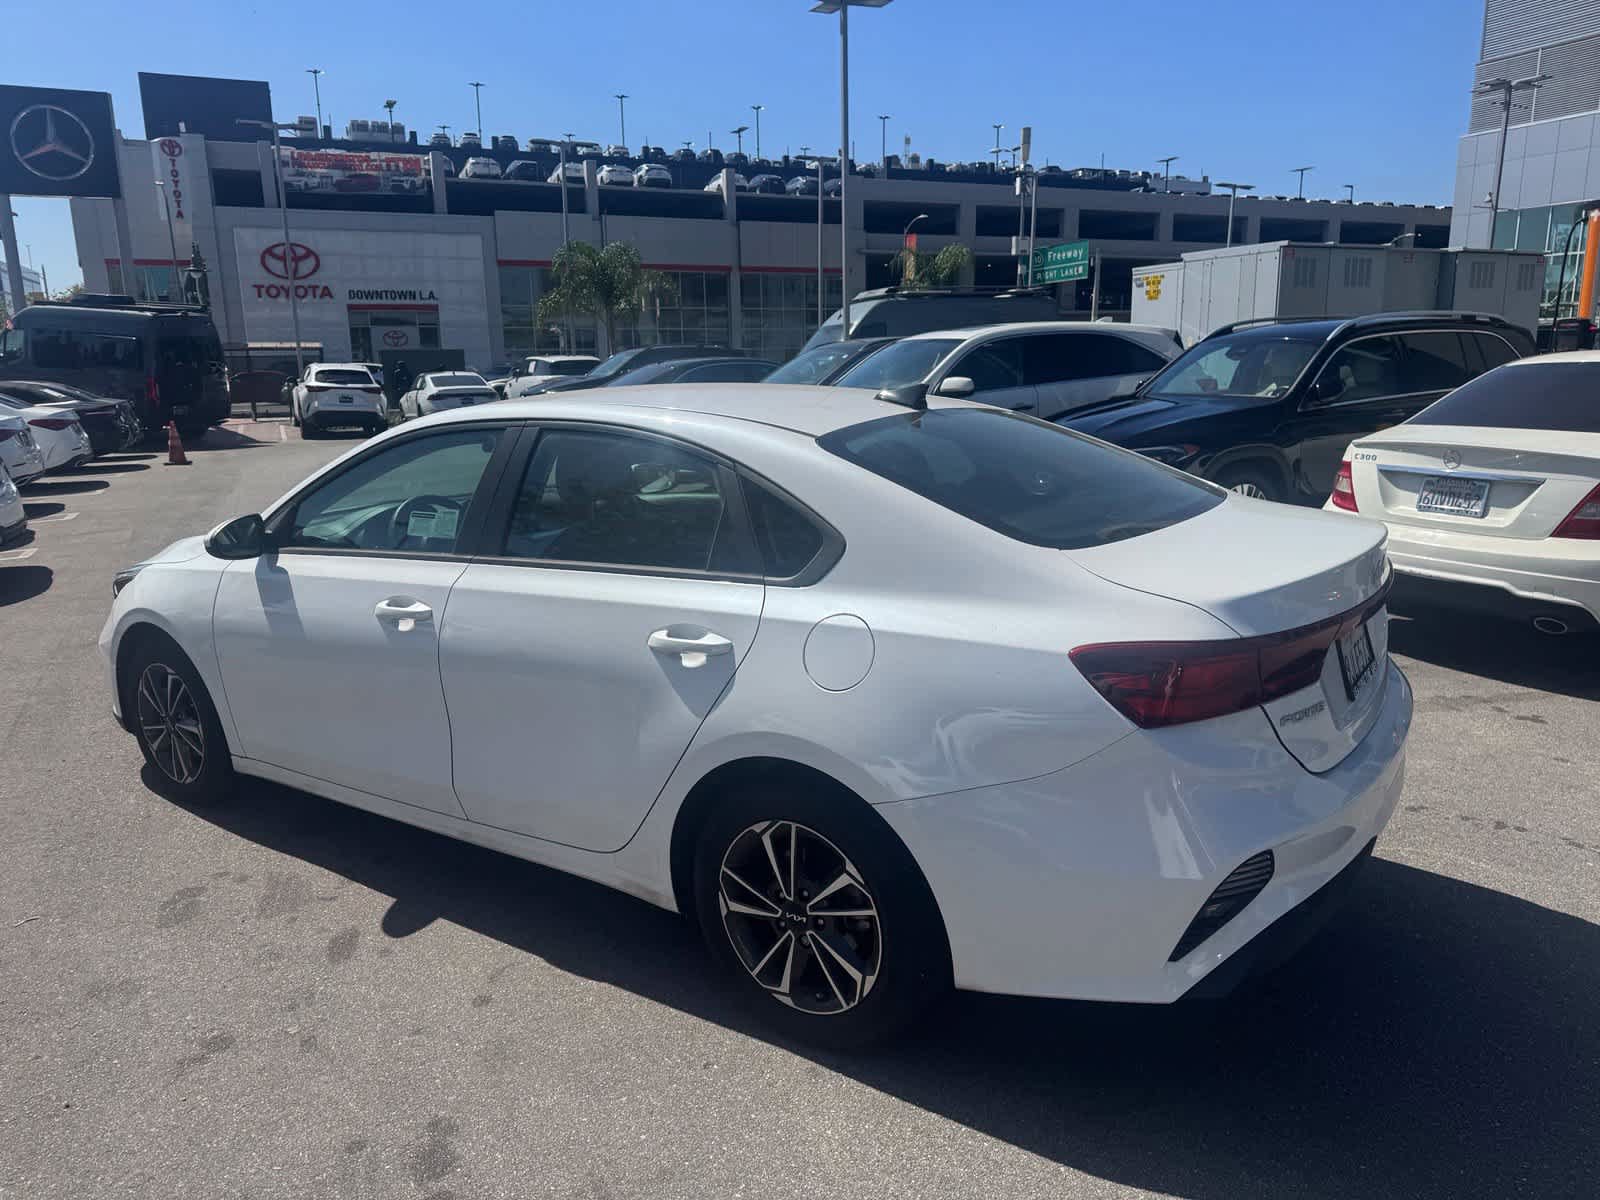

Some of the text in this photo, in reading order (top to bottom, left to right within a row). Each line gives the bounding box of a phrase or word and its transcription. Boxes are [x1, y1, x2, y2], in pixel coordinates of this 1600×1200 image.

[168, 158, 184, 219] TOYOTA
[1047, 248, 1083, 262] Freeway
[252, 284, 333, 299] TOYOTA
[348, 289, 417, 301] DOWNTOWN
